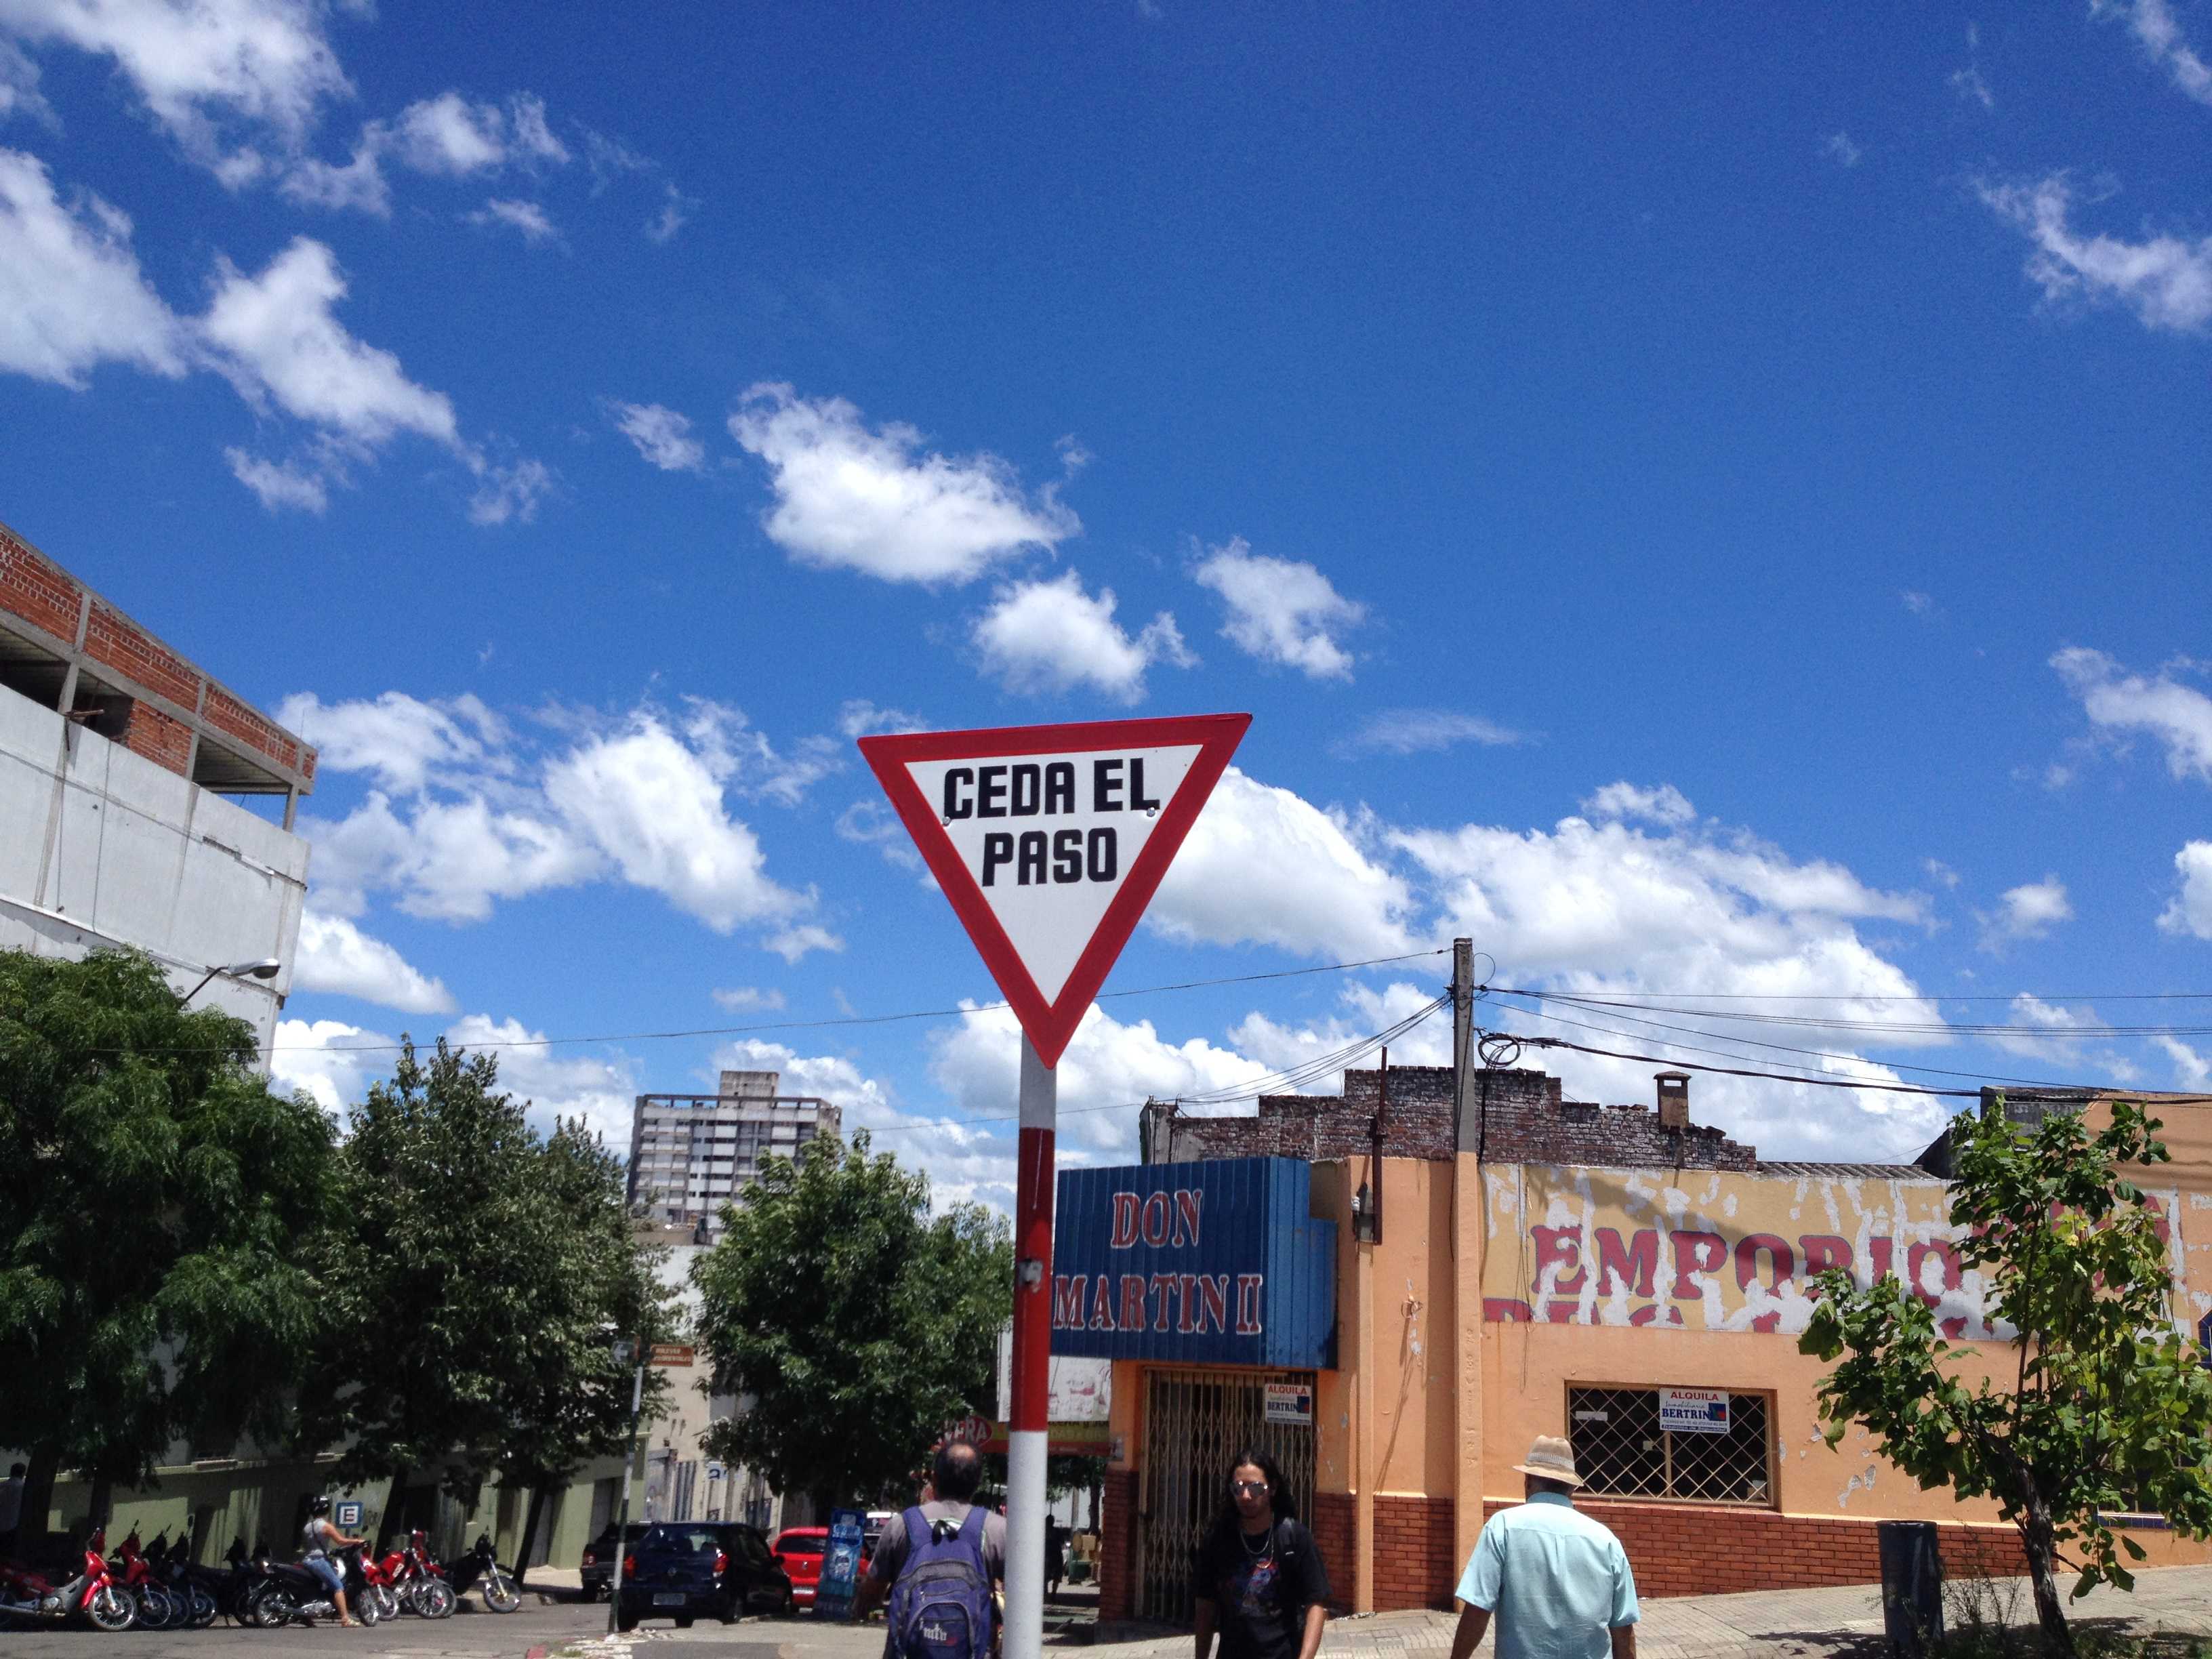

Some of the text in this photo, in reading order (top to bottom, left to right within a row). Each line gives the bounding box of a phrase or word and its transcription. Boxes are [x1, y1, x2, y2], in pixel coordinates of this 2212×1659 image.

[943, 757, 1160, 820] CEDA EL
[982, 827, 1118, 887] PASO
[1109, 1188, 1203, 1249] DON
[1052, 1271, 1263, 1335] MARTIN II
[1268, 1385, 1307, 1395] ALQUILA
[1670, 1391, 1719, 1401] ALQUILA
[343, 1508, 355, 1522] E
